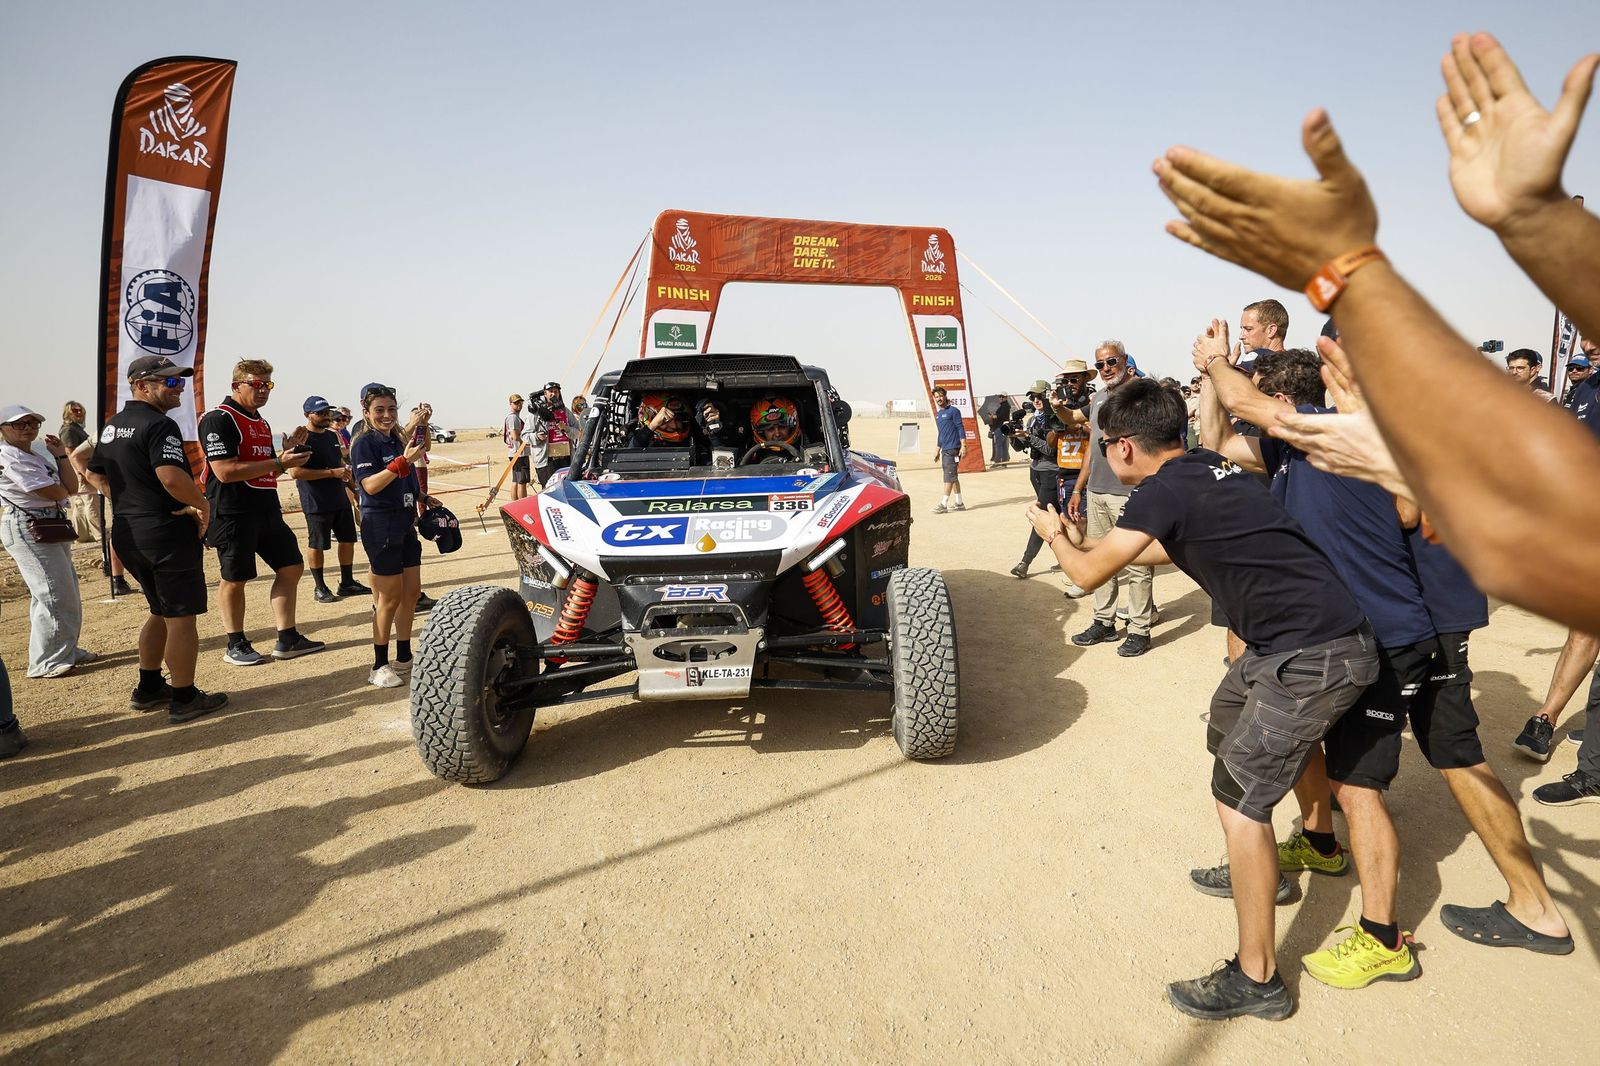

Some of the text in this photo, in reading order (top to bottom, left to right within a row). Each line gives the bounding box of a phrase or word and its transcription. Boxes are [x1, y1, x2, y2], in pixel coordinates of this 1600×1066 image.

[139, 126, 211, 168] DAKAR
[793, 235, 839, 248] DREAM.
[669, 246, 700, 264] DAKAR
[793, 246, 828, 258] DARE.
[675, 263, 696, 272] 2026
[793, 257, 835, 269] LIVE IT.
[921, 259, 946, 274] DAKAR
[657, 286, 710, 301] FINISH
[912, 295, 954, 306] FINISH
[932, 364, 962, 372] CONGRATS!
[959, 398, 967, 406] 13
[207, 449, 228, 457] IVECO
[1061, 441, 1081, 456] 27
[162, 453, 184, 463] IVECO
[647, 499, 754, 513] Ralarsa
[773, 500, 809, 511] 336
[817, 495, 850, 528] BFGoodrich
[550, 507, 571, 541] BFGoodrich
[695, 517, 772, 531] Racing
[614, 523, 682, 541] tx
[664, 585, 728, 600] BBR
[701, 669, 750, 679] KLE-TA-231
[1366, 709, 1395, 721] sparco
